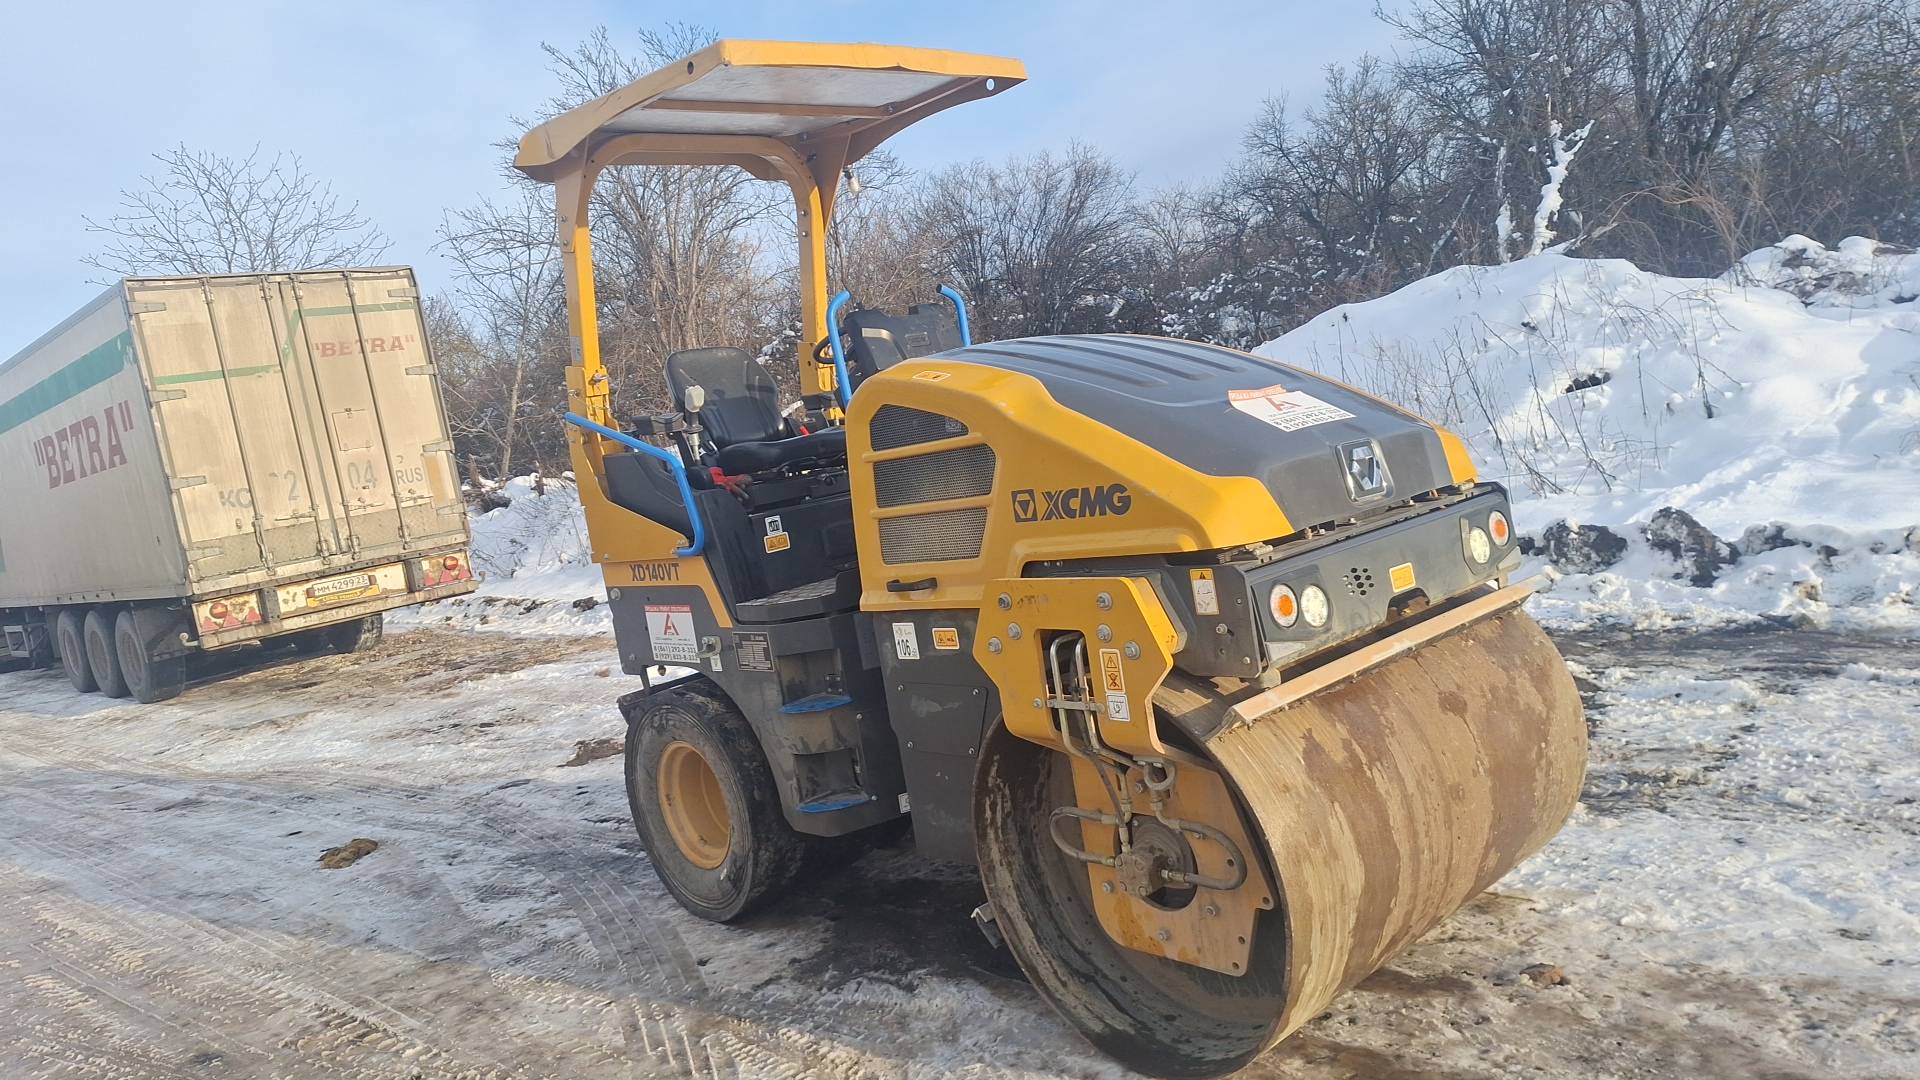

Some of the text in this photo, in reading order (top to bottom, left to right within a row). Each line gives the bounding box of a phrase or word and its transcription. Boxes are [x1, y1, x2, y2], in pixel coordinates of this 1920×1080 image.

[312, 335, 415, 358] "BETRA"
[33, 400, 134, 489] "BETRA"
[396, 467, 424, 485] RUS
[1040, 483, 1132, 521] XCMG
[629, 562, 680, 582] XD140VT
[331, 578, 355, 591] 4299
[897, 639, 912, 656] 106
